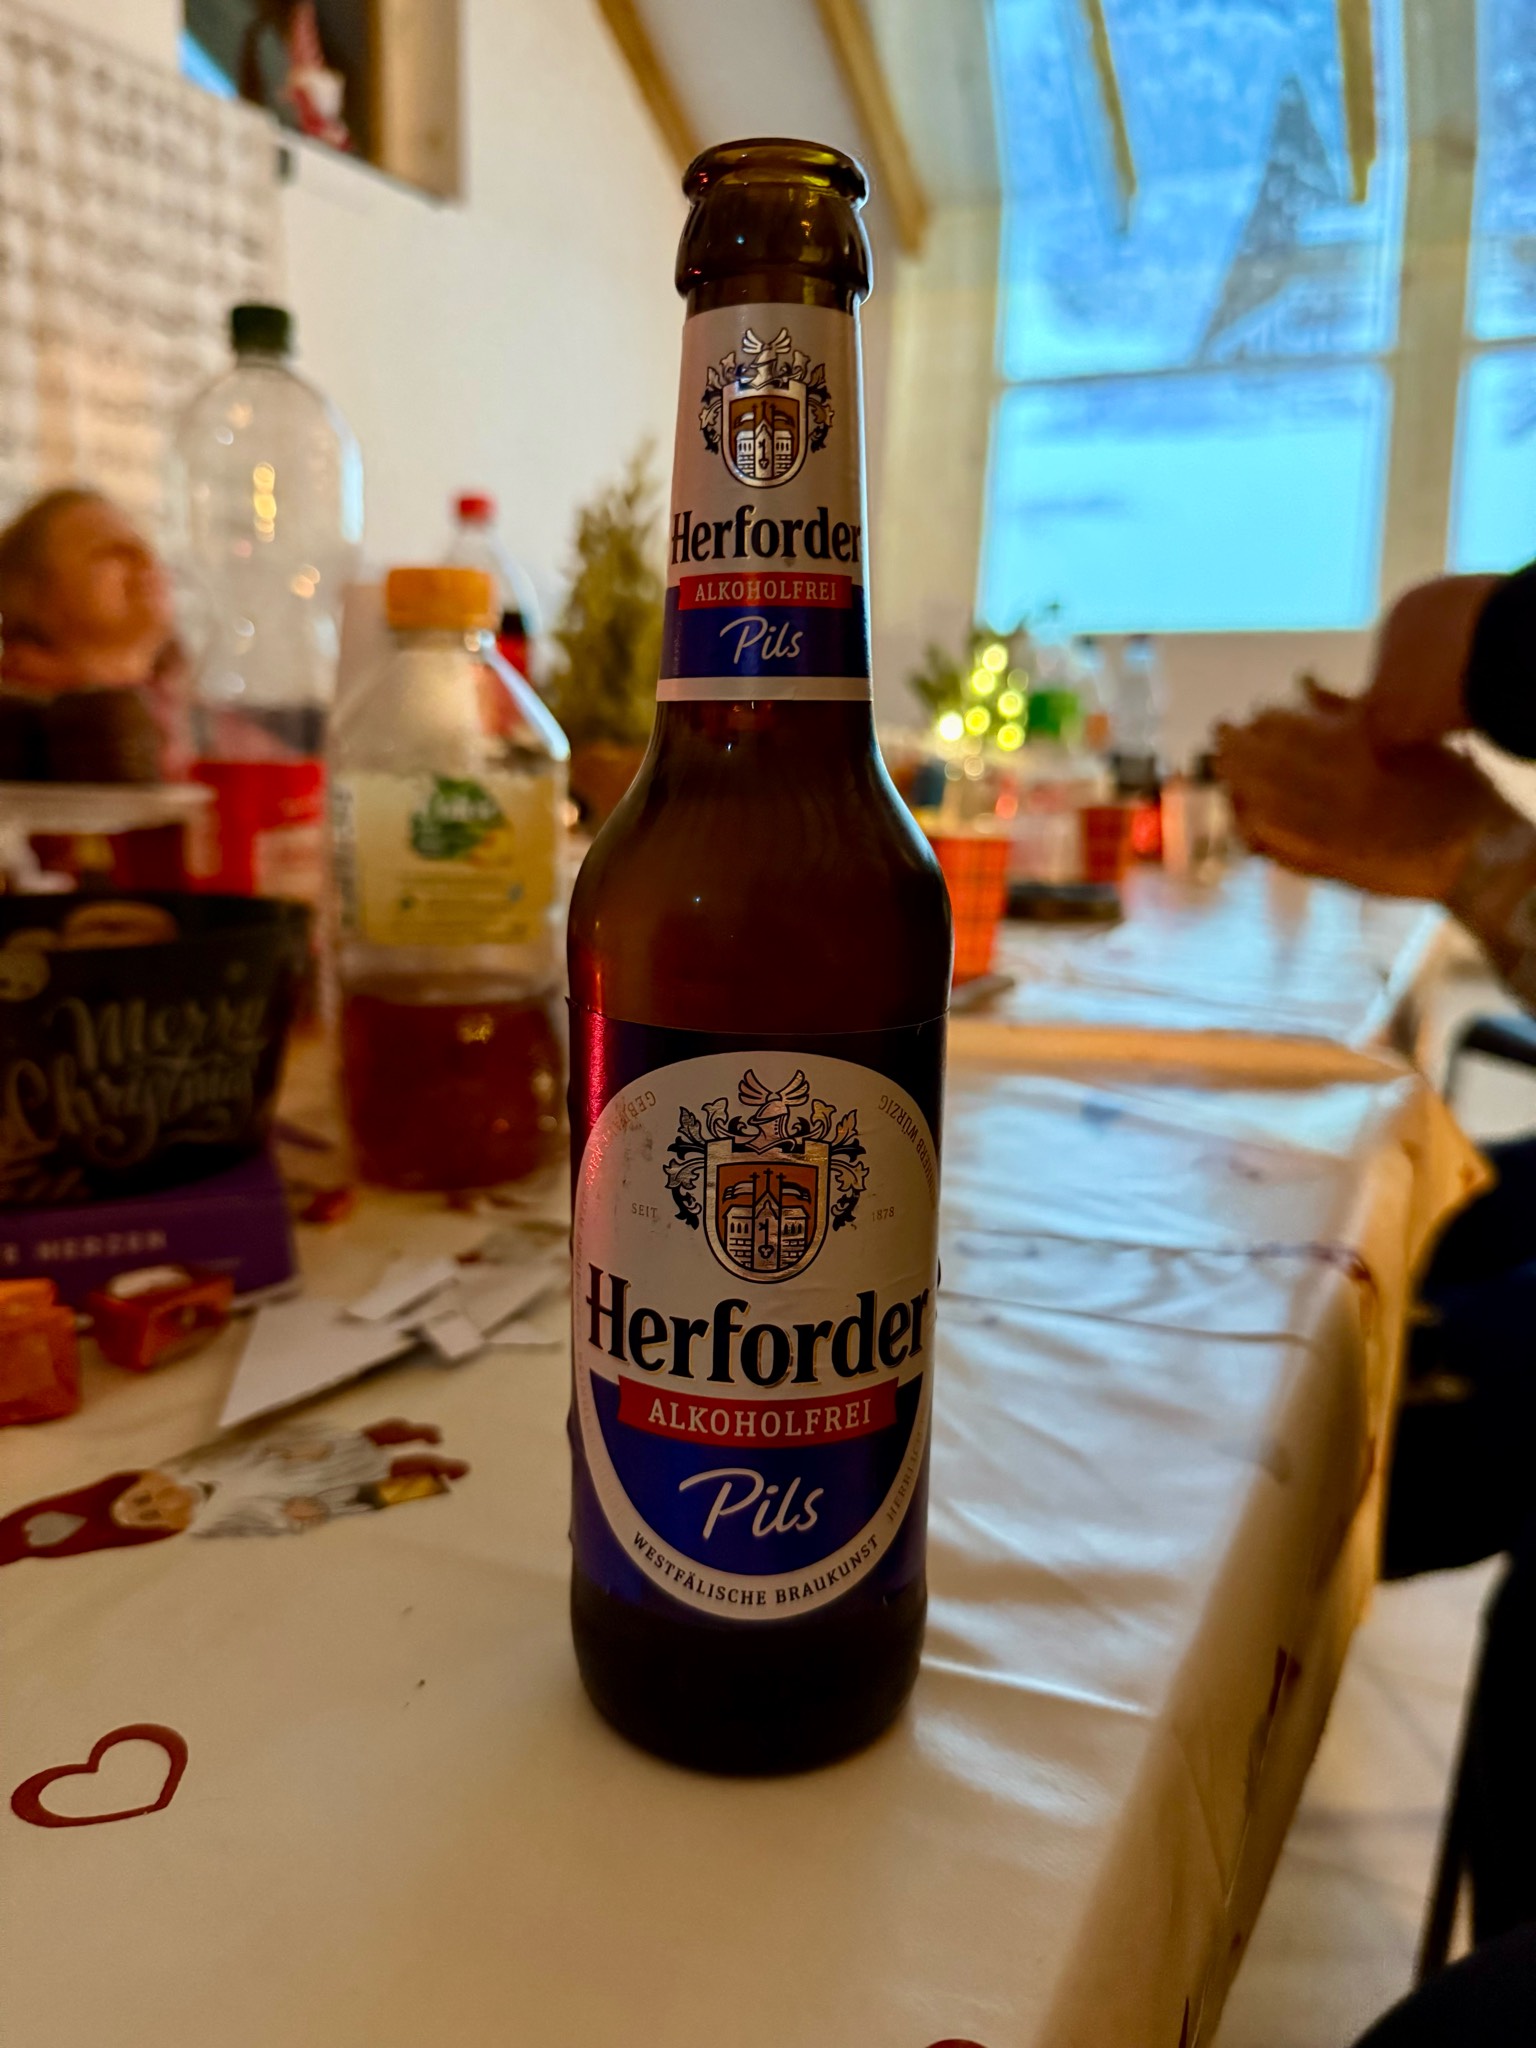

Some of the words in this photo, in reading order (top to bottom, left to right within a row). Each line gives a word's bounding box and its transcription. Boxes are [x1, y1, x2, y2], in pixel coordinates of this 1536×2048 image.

[671, 504, 860, 564] Herforder
[695, 579, 836, 602] ALKOHOLFREI
[719, 615, 803, 664] Pils
[878, 1094, 920, 1141] WÜRZIG
[631, 1202, 659, 1219] SEIT
[872, 1206, 895, 1223] 1878
[585, 1262, 930, 1388] Herforder
[648, 1398, 871, 1437] ALKOHOLFREI
[678, 1467, 824, 1541] Pils
[632, 1531, 767, 1606] WESTFÄLISCHE
[776, 1534, 879, 1604] BRAUKUNST
